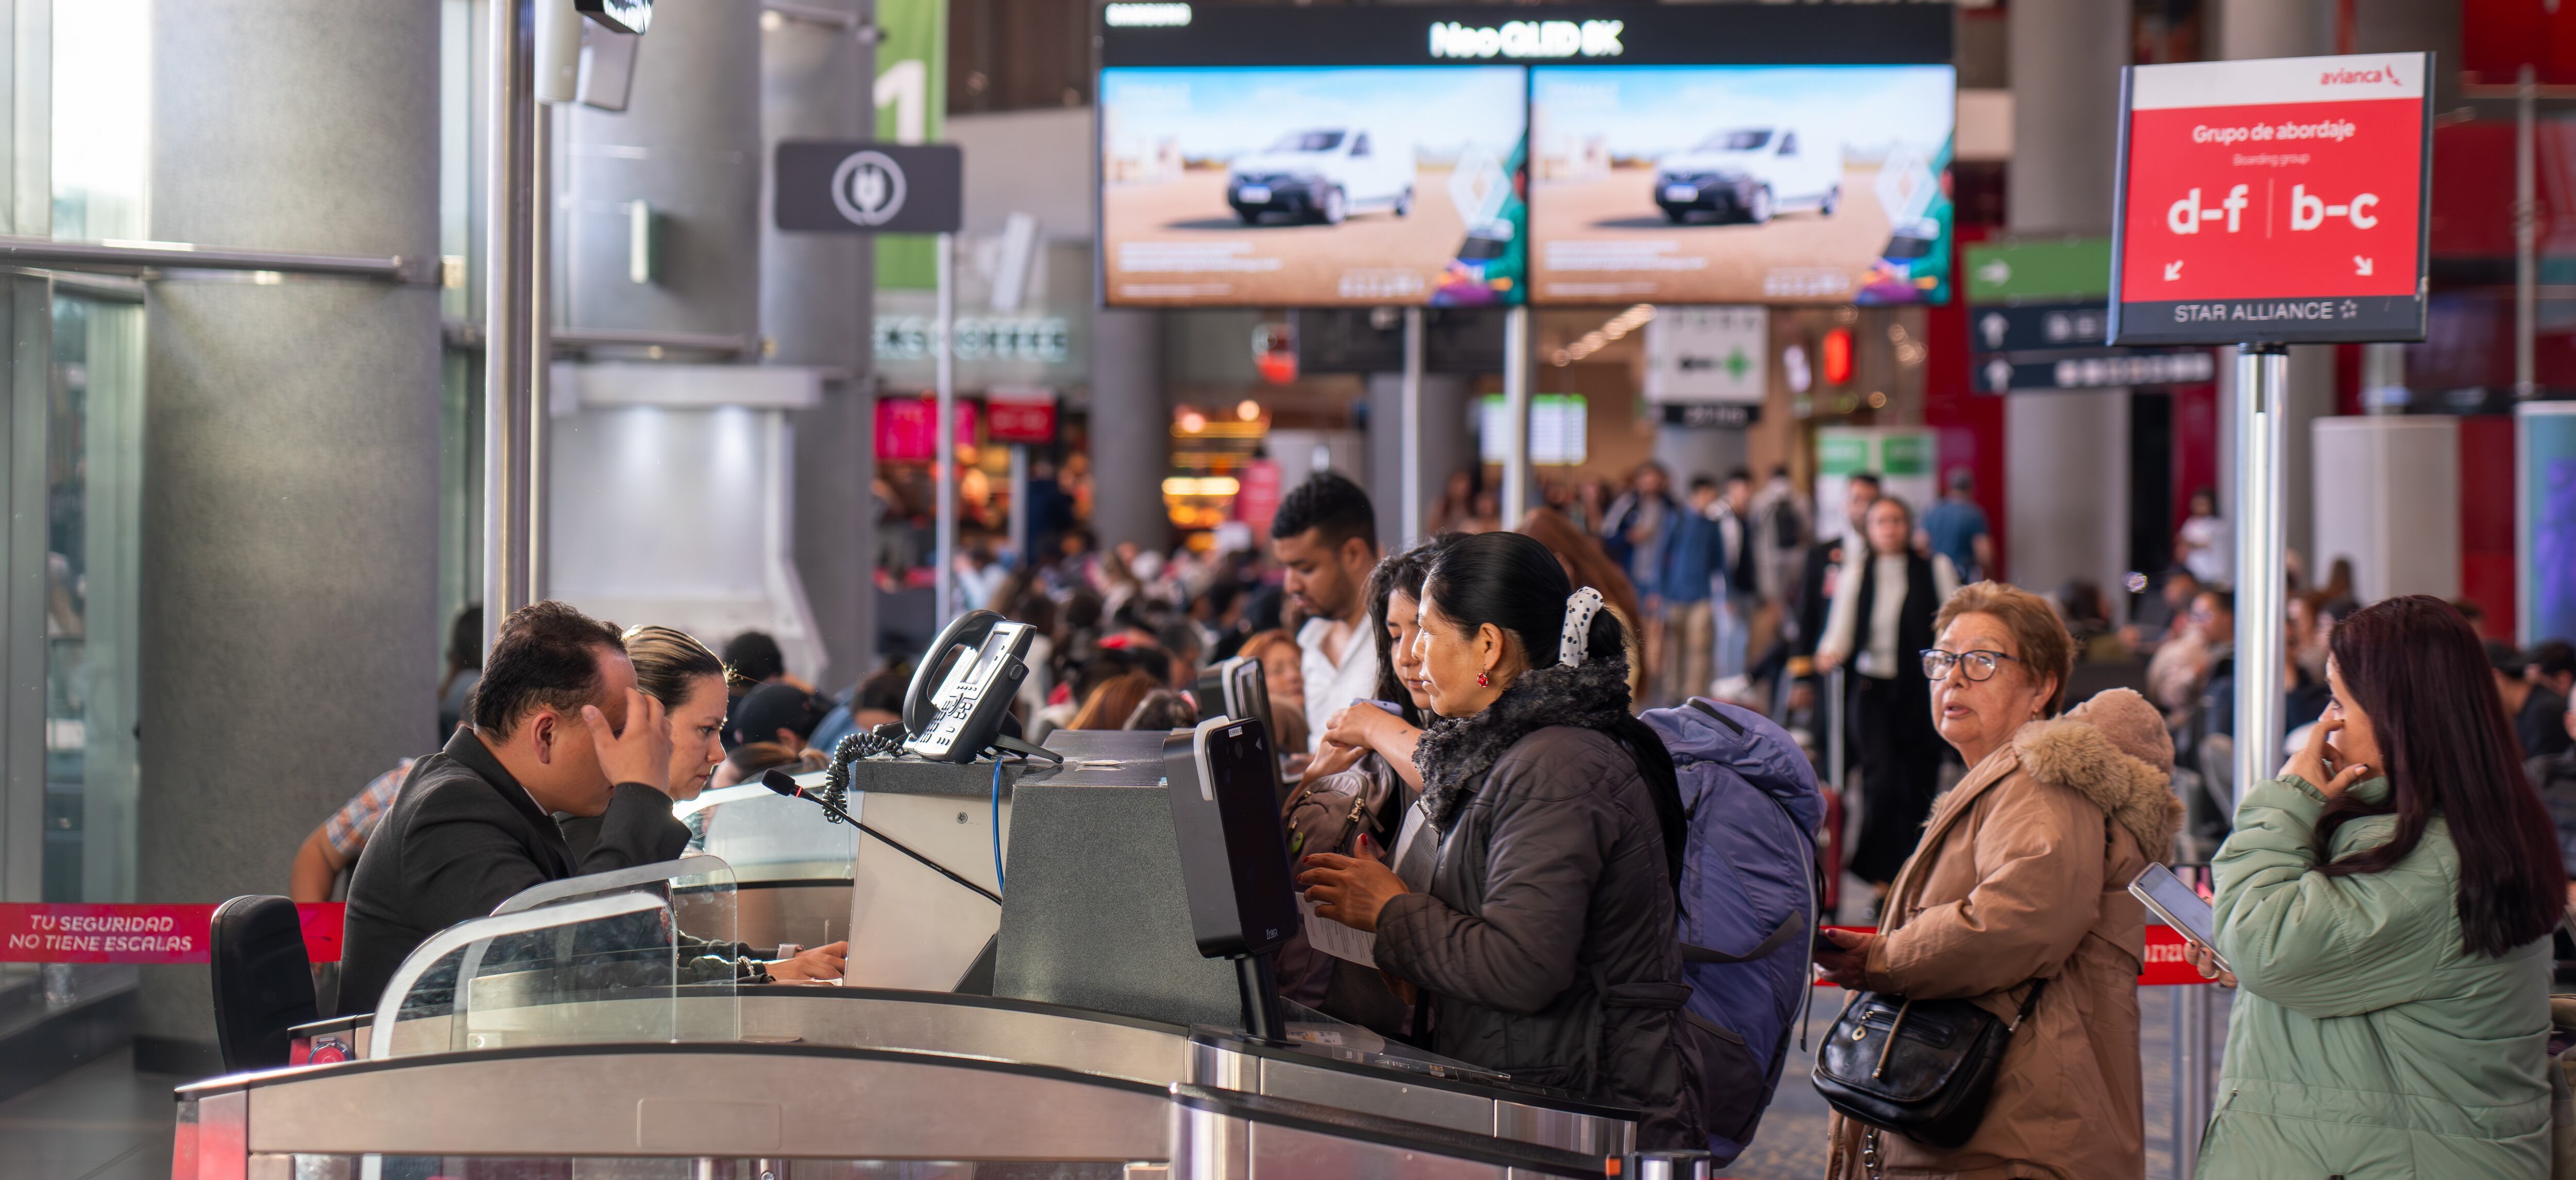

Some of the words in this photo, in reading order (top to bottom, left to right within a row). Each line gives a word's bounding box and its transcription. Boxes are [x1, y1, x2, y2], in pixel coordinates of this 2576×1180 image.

[1429, 22, 1500, 58] Neo
[1500, 20, 1582, 58] QLED
[2320, 66, 2382, 85] avianca
[2192, 125, 2249, 146] Grupo
[2250, 123, 2274, 141] de
[2276, 118, 2356, 142] abordaje
[2232, 153, 2279, 167] Boarding
[2280, 154, 2311, 167] group
[2167, 183, 2249, 234] d-f
[2291, 183, 2380, 231] b-c
[2175, 304, 2227, 323] STAR
[2232, 301, 2334, 321] ALLIANCE
[30, 915, 56, 930] TU
[59, 916, 174, 933] SEGURIDAD
[8, 933, 40, 950] NO
[44, 934, 101, 951] TIENE
[104, 935, 193, 952] ESCALAS
